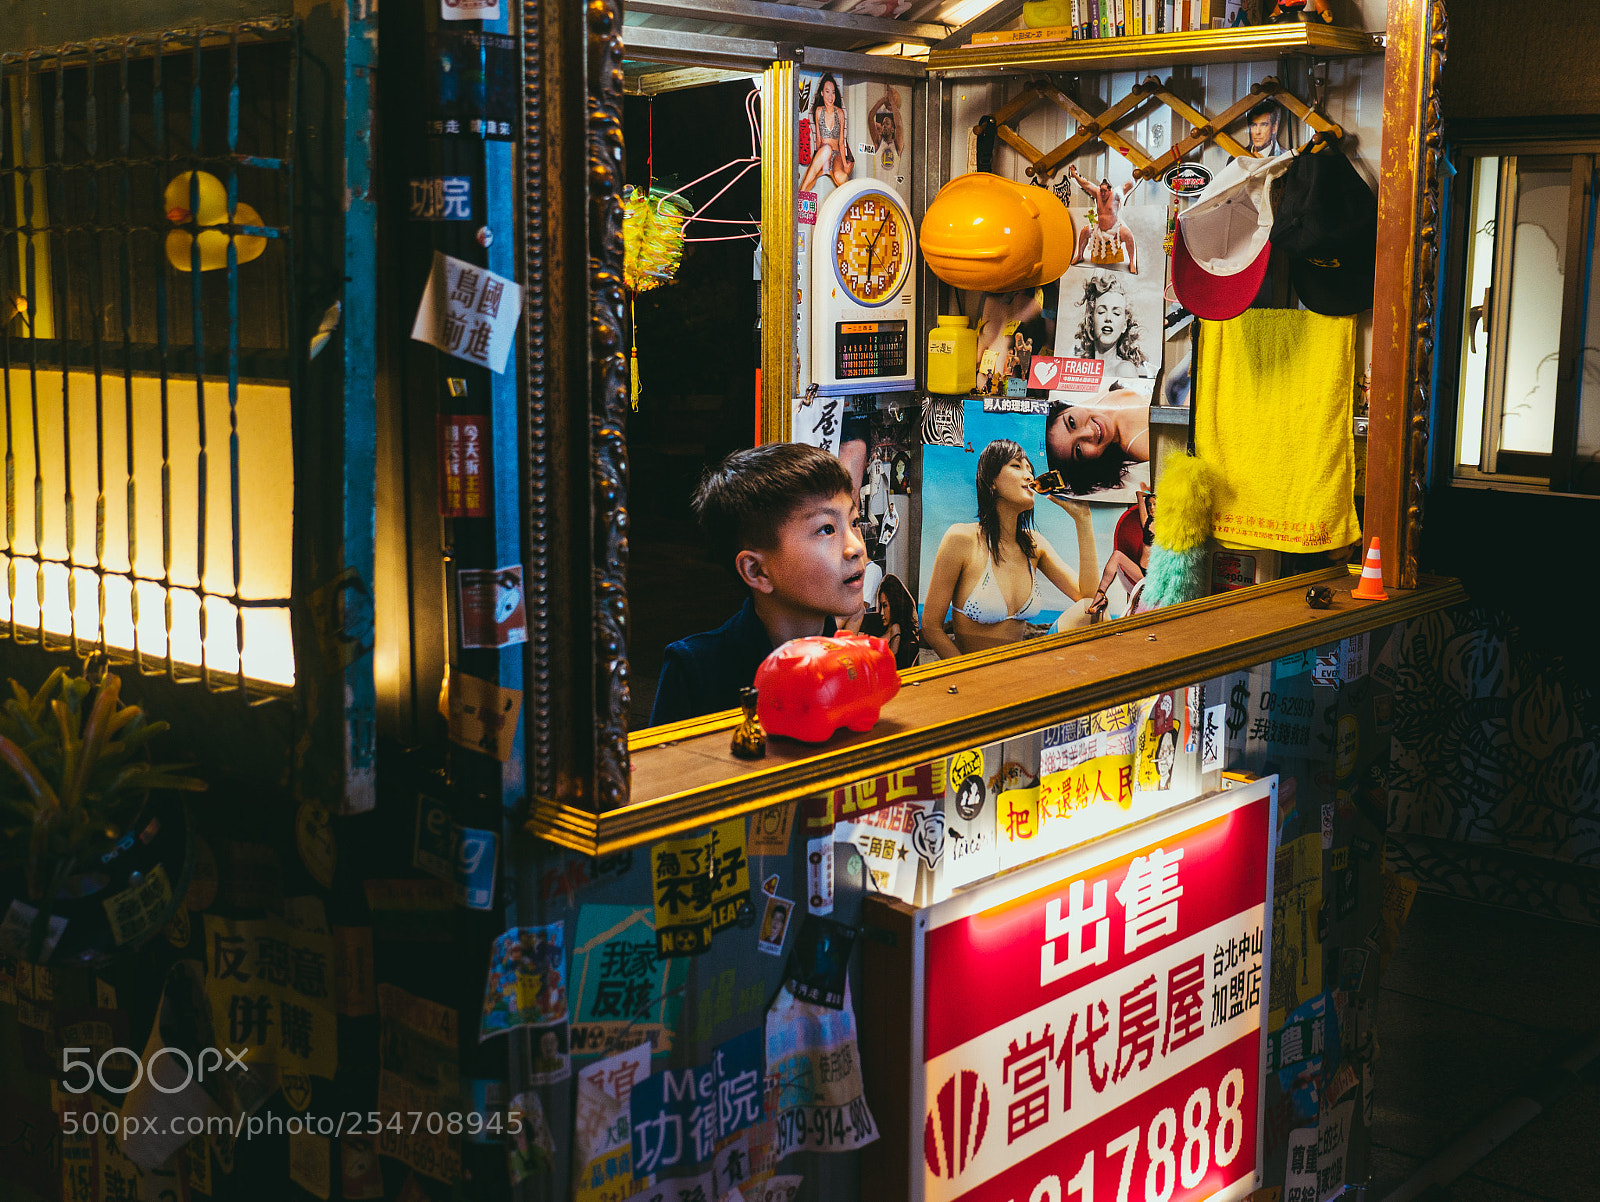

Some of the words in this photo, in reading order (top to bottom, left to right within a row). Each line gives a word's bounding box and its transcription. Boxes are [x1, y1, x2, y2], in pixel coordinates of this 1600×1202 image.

[850, 206, 860, 219] 11
[864, 201, 874, 214] 12
[880, 207, 885, 220] 1
[840, 221, 851, 234] 10
[889, 222, 896, 235] 2
[837, 241, 844, 254] 9
[893, 242, 899, 255] 3
[841, 261, 848, 274] 8
[888, 262, 895, 274] 4
[851, 276, 857, 289] 7
[865, 282, 871, 294] 6
[878, 277, 884, 290] 5
[451, 268, 504, 319] 島國
[445, 310, 493, 361] 前進
[1065, 361, 1101, 374] FRAGILE
[984, 398, 1049, 413] 男人的理想尺寸
[1045, 717, 1090, 746] 功德院
[1006, 764, 1133, 842] 把家還給人民
[859, 835, 896, 860] 三角窗
[1040, 848, 1184, 987] 出售
[600, 940, 658, 978] 我家
[1212, 925, 1263, 978] 台北中山
[214, 932, 328, 998] 反惡意
[591, 978, 655, 1019] 反核
[1210, 962, 1262, 1028] 加盟店
[1002, 954, 1205, 1146] 當代房屋
[634, 1069, 759, 1173] 功德院
[1007, 1067, 1244, 1202] 17888
